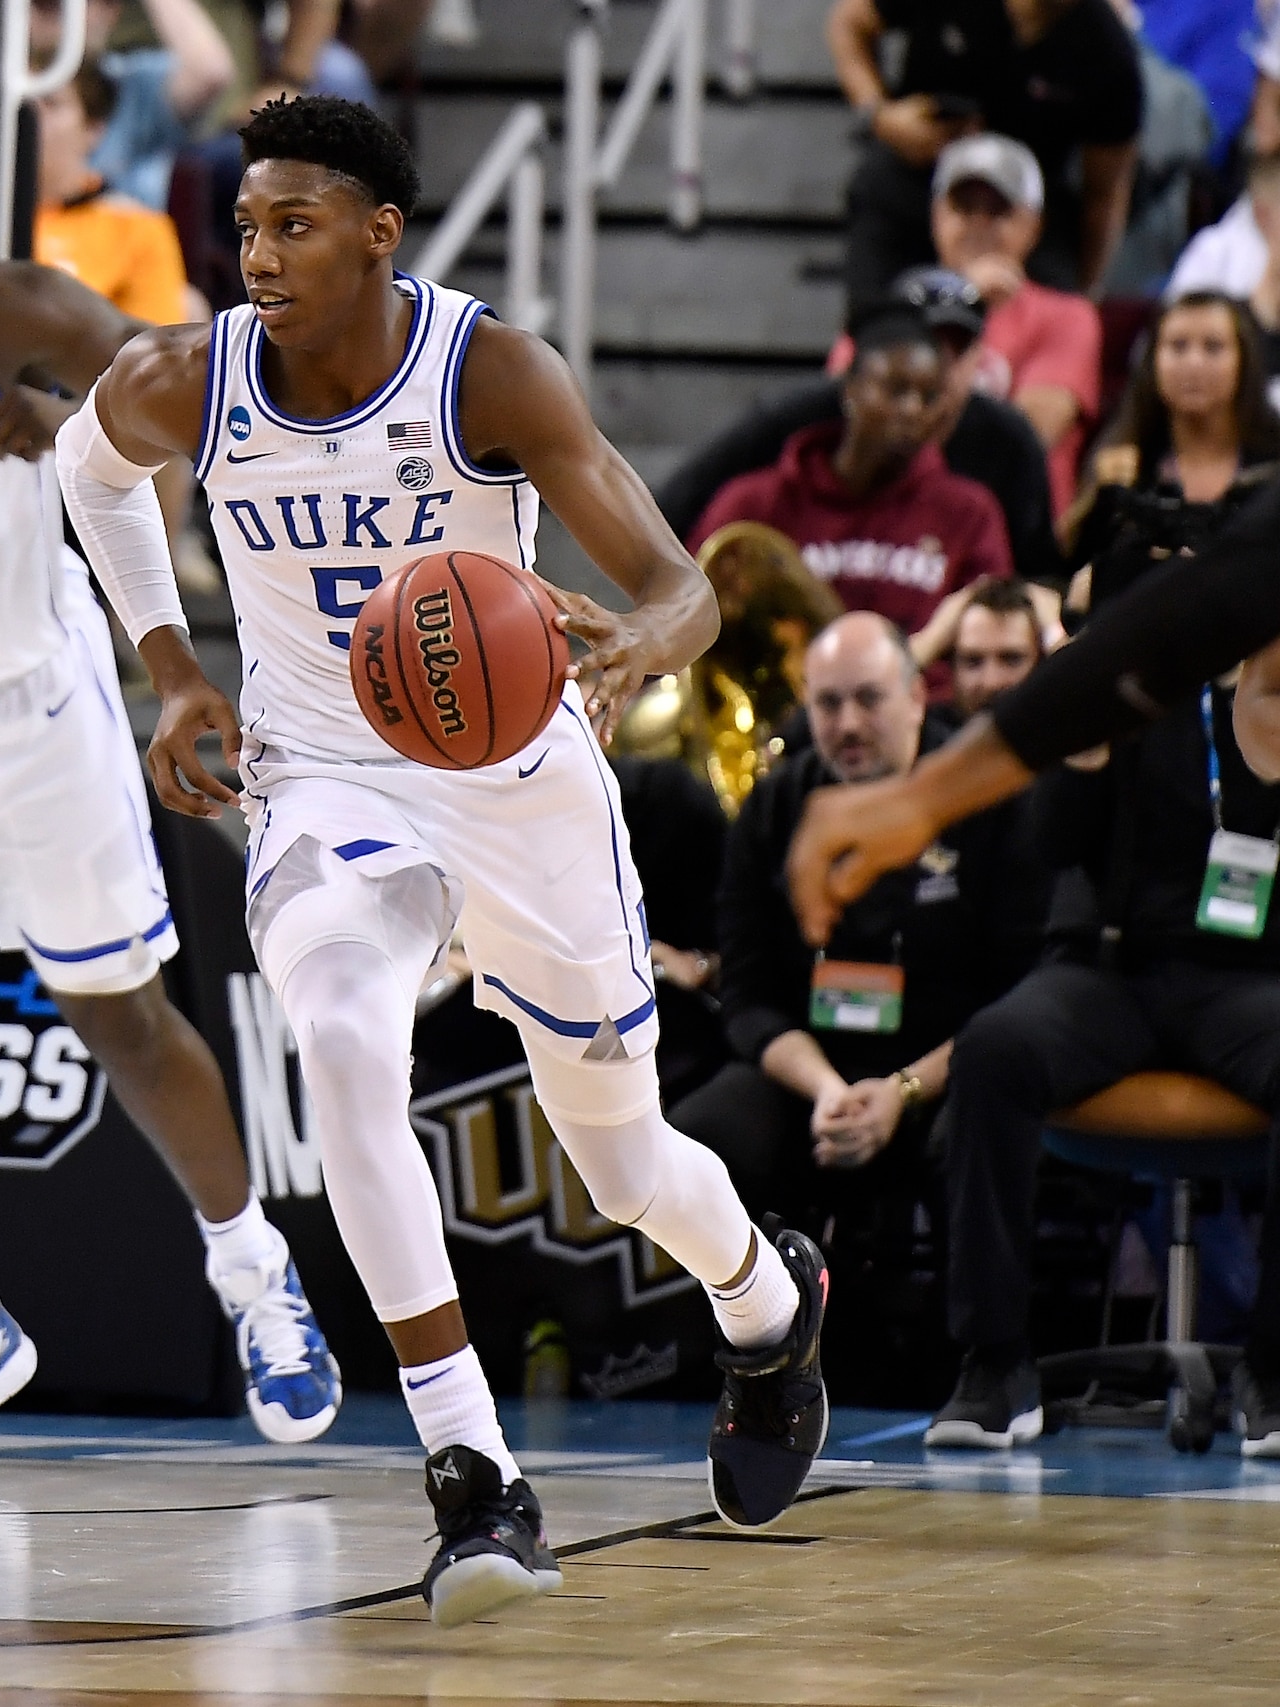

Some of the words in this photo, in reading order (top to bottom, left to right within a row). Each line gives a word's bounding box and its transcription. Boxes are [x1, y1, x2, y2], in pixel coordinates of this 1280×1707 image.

[224, 490, 454, 550] DUKE
[308, 566, 384, 650] 5
[364, 624, 404, 726] NCAA
[413, 587, 469, 738] Wilson
